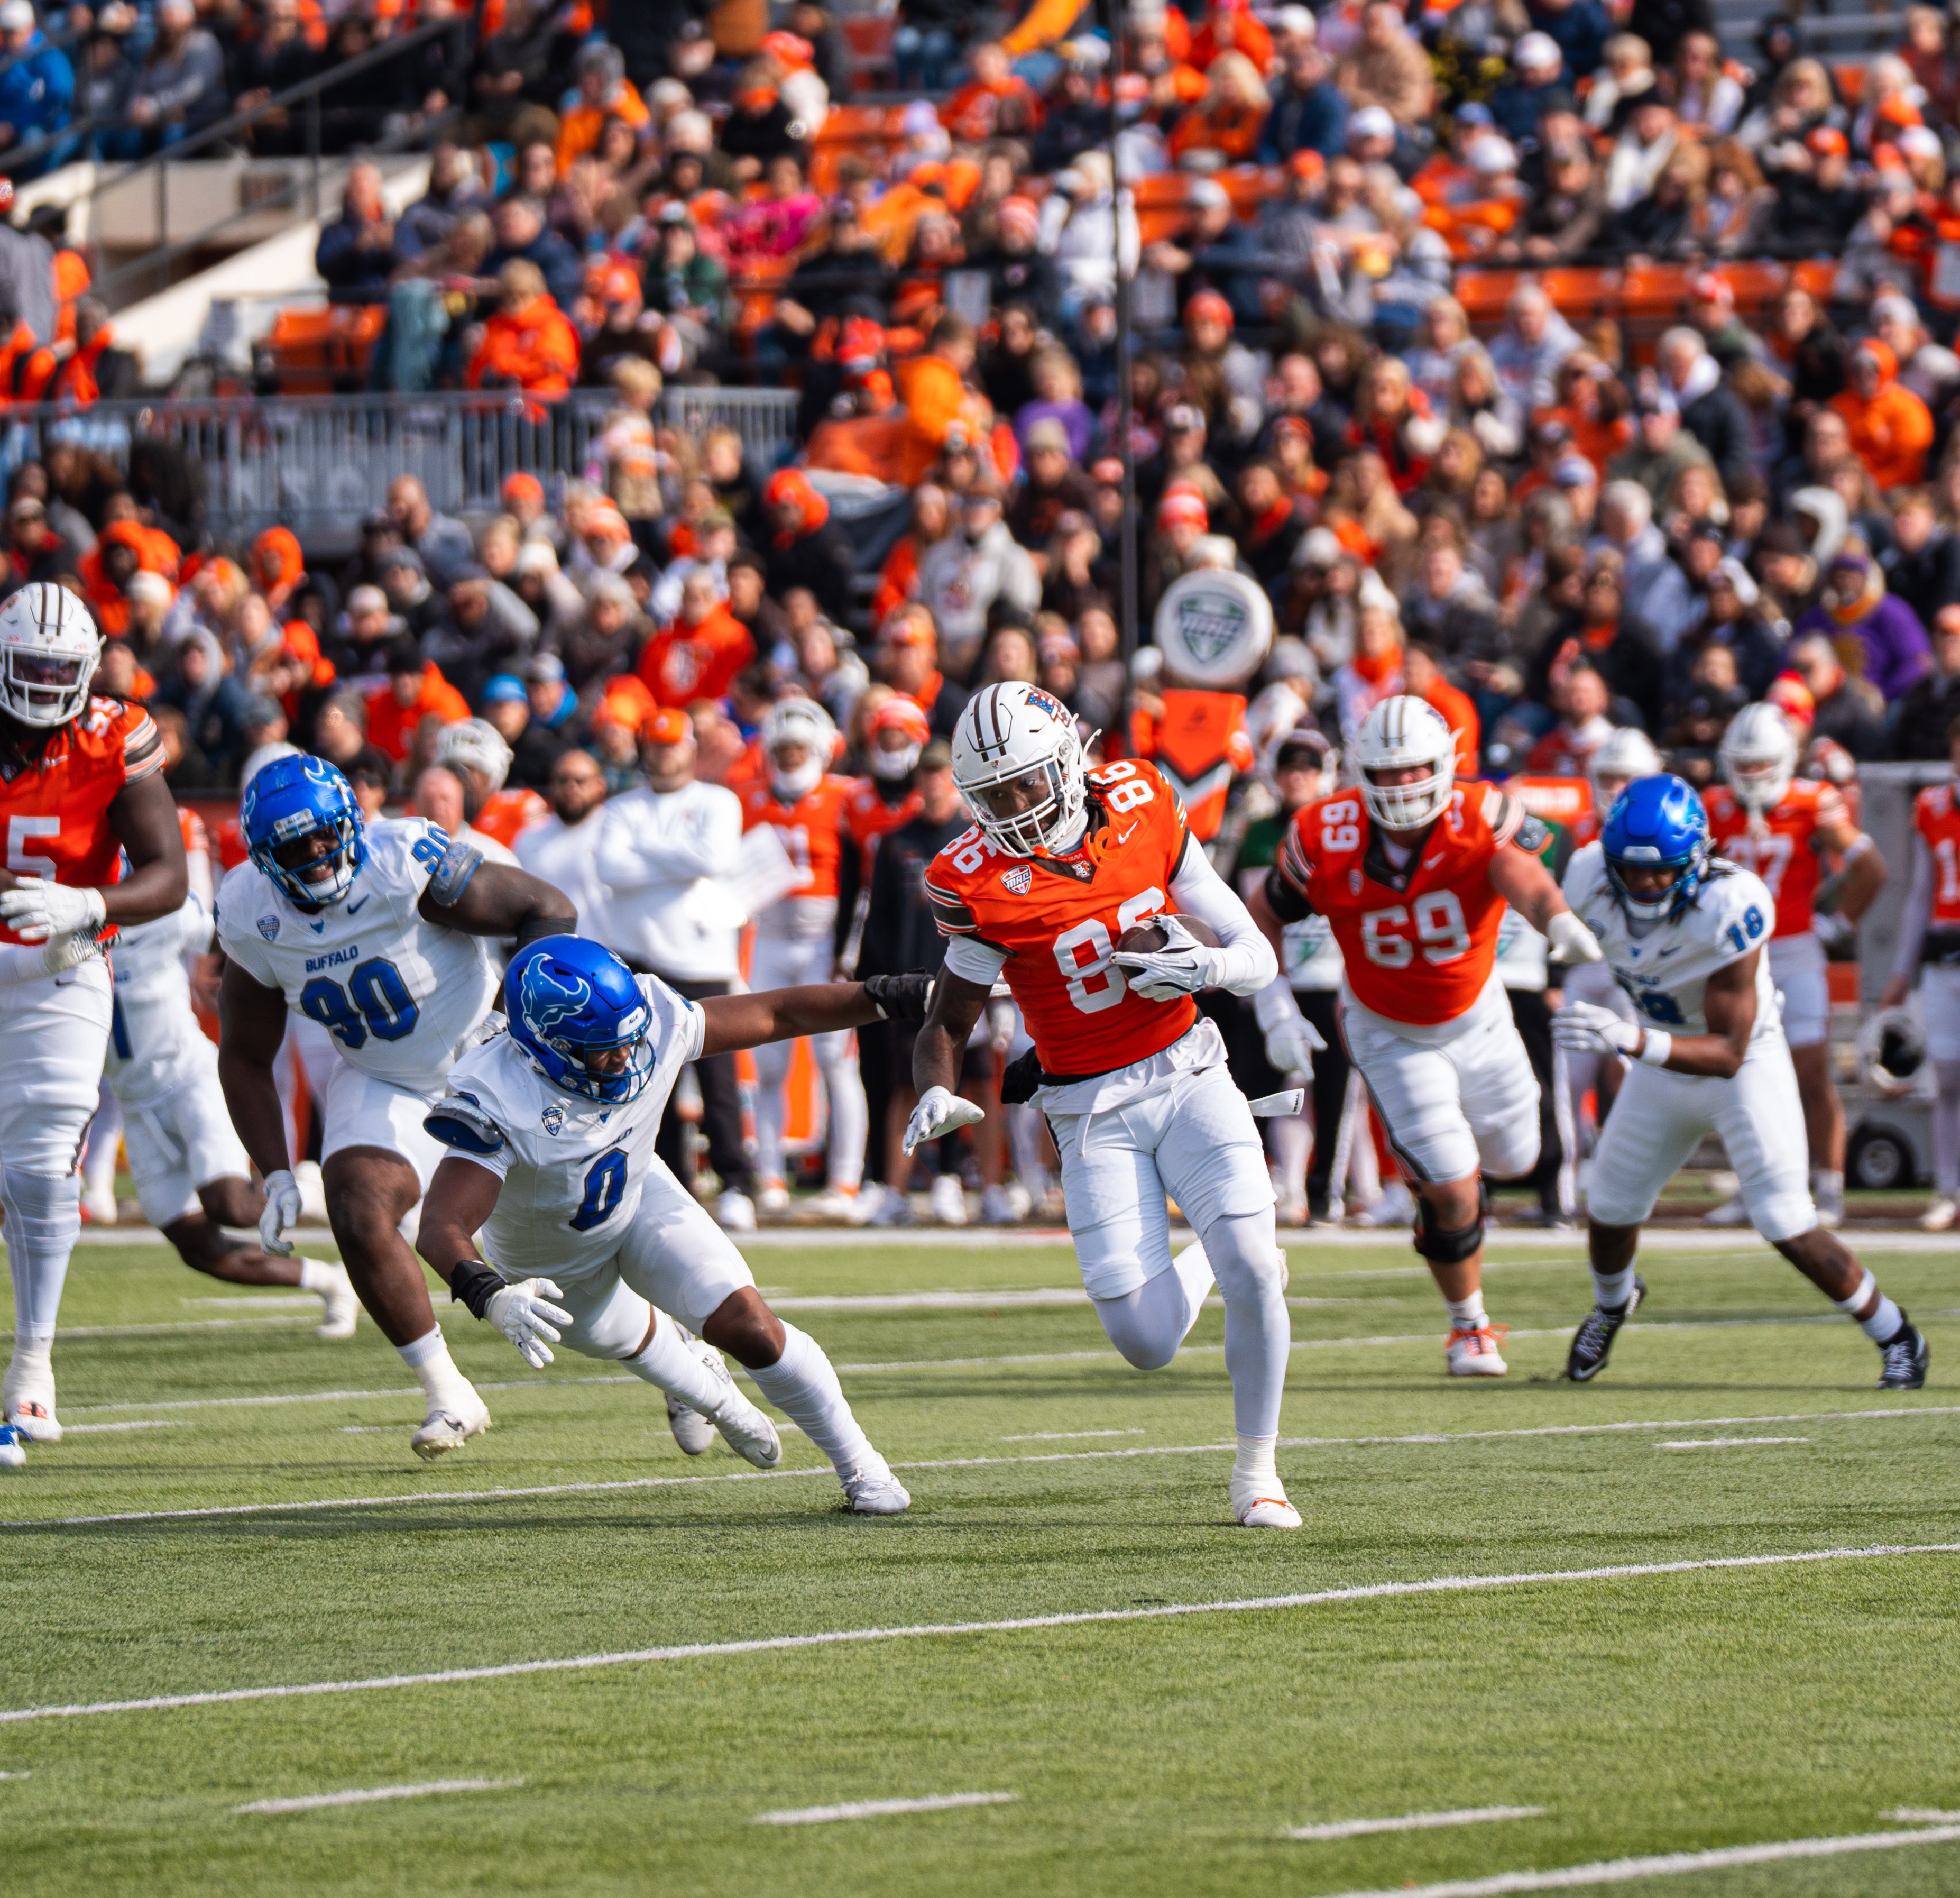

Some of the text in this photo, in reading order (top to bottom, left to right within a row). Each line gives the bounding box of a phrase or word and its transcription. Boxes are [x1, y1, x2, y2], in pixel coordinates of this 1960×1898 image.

[411, 826, 449, 875] 90
[940, 825, 1002, 874] 86
[1321, 799, 1360, 853] 69
[1006, 872, 1030, 888] MAC
[1360, 888, 1471, 970] 69
[1726, 905, 1764, 952] 18
[305, 944, 358, 973] BUFFALO
[300, 956, 420, 1049] 90
[544, 1113, 563, 1127] MAC
[569, 1147, 629, 1232] 0
